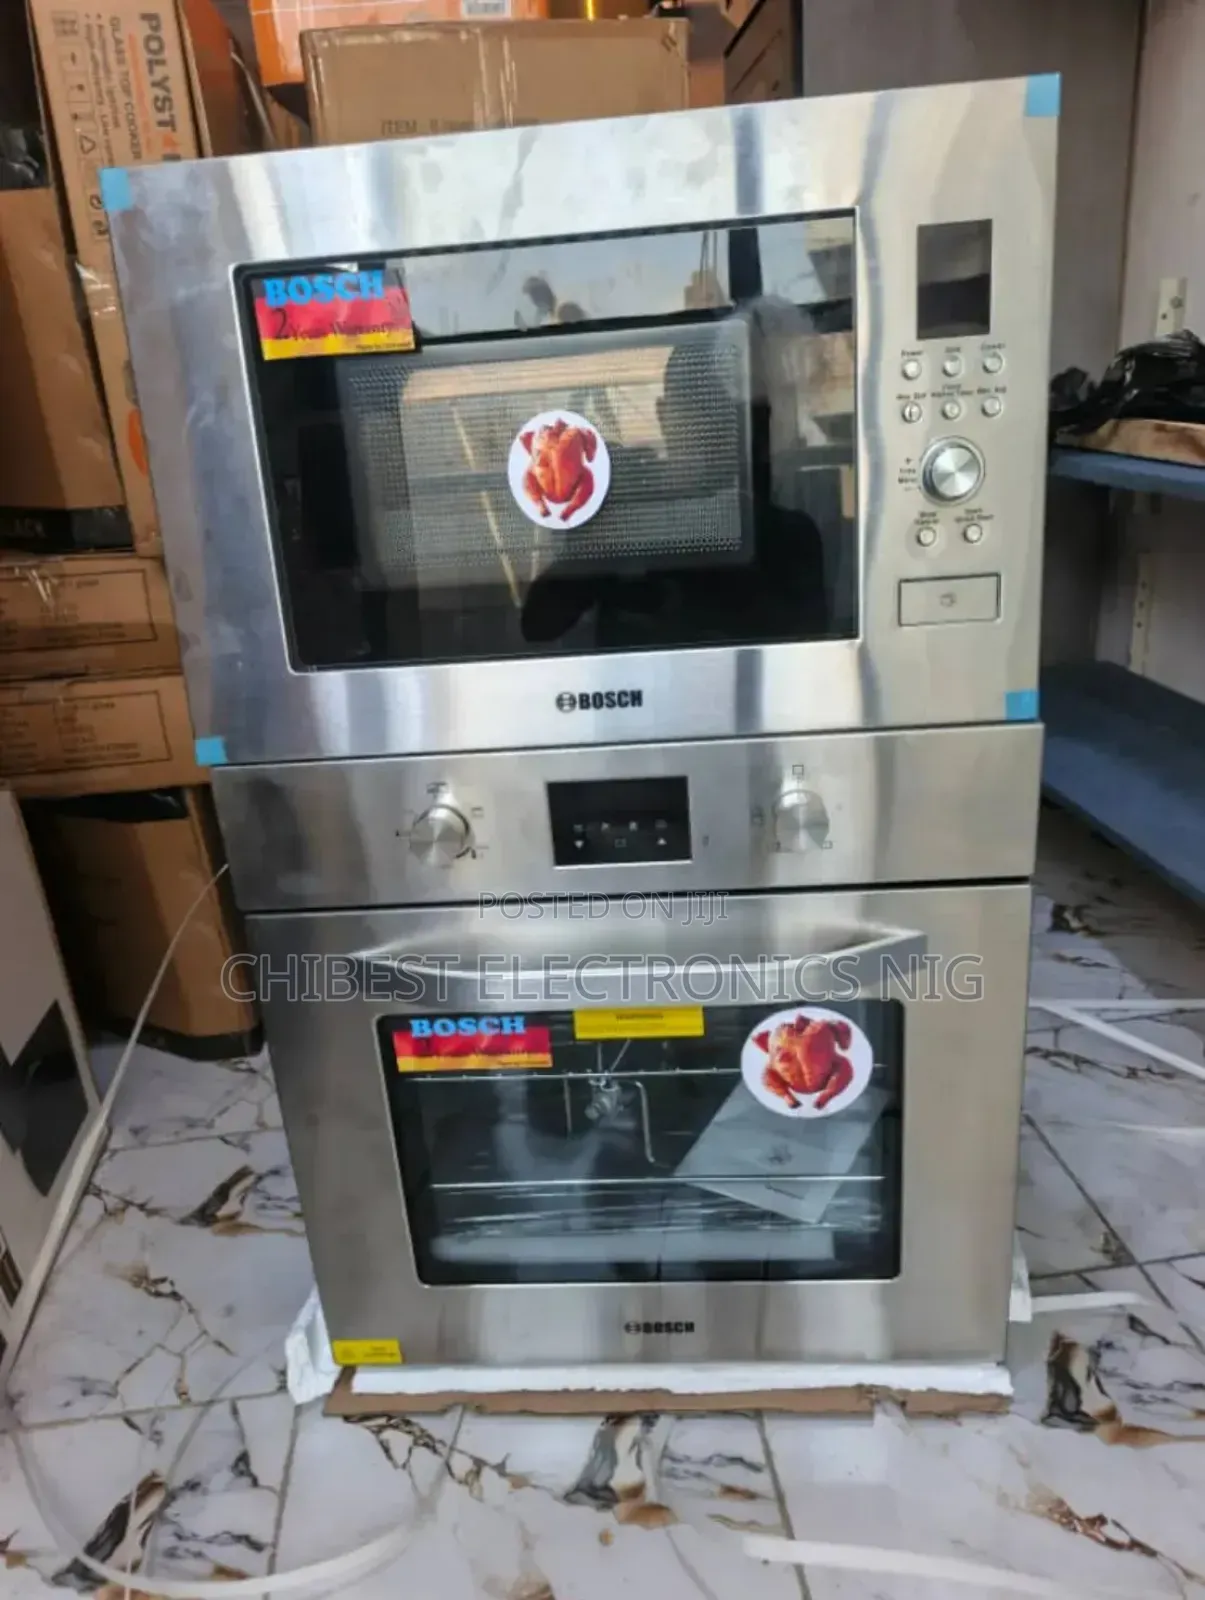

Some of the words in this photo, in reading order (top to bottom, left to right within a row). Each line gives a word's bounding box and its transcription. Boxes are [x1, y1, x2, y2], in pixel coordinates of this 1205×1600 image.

[109, 15, 126, 65] GLASS
[119, 70, 132, 98] TOP
[124, 101, 142, 160] COOKER
[262, 269, 385, 307] BOSCH
[275, 308, 293, 340] 2
[578, 689, 643, 710] BOSCH
[409, 1015, 527, 1037] BOSCH
[642, 1321, 695, 1334] BOSCH
